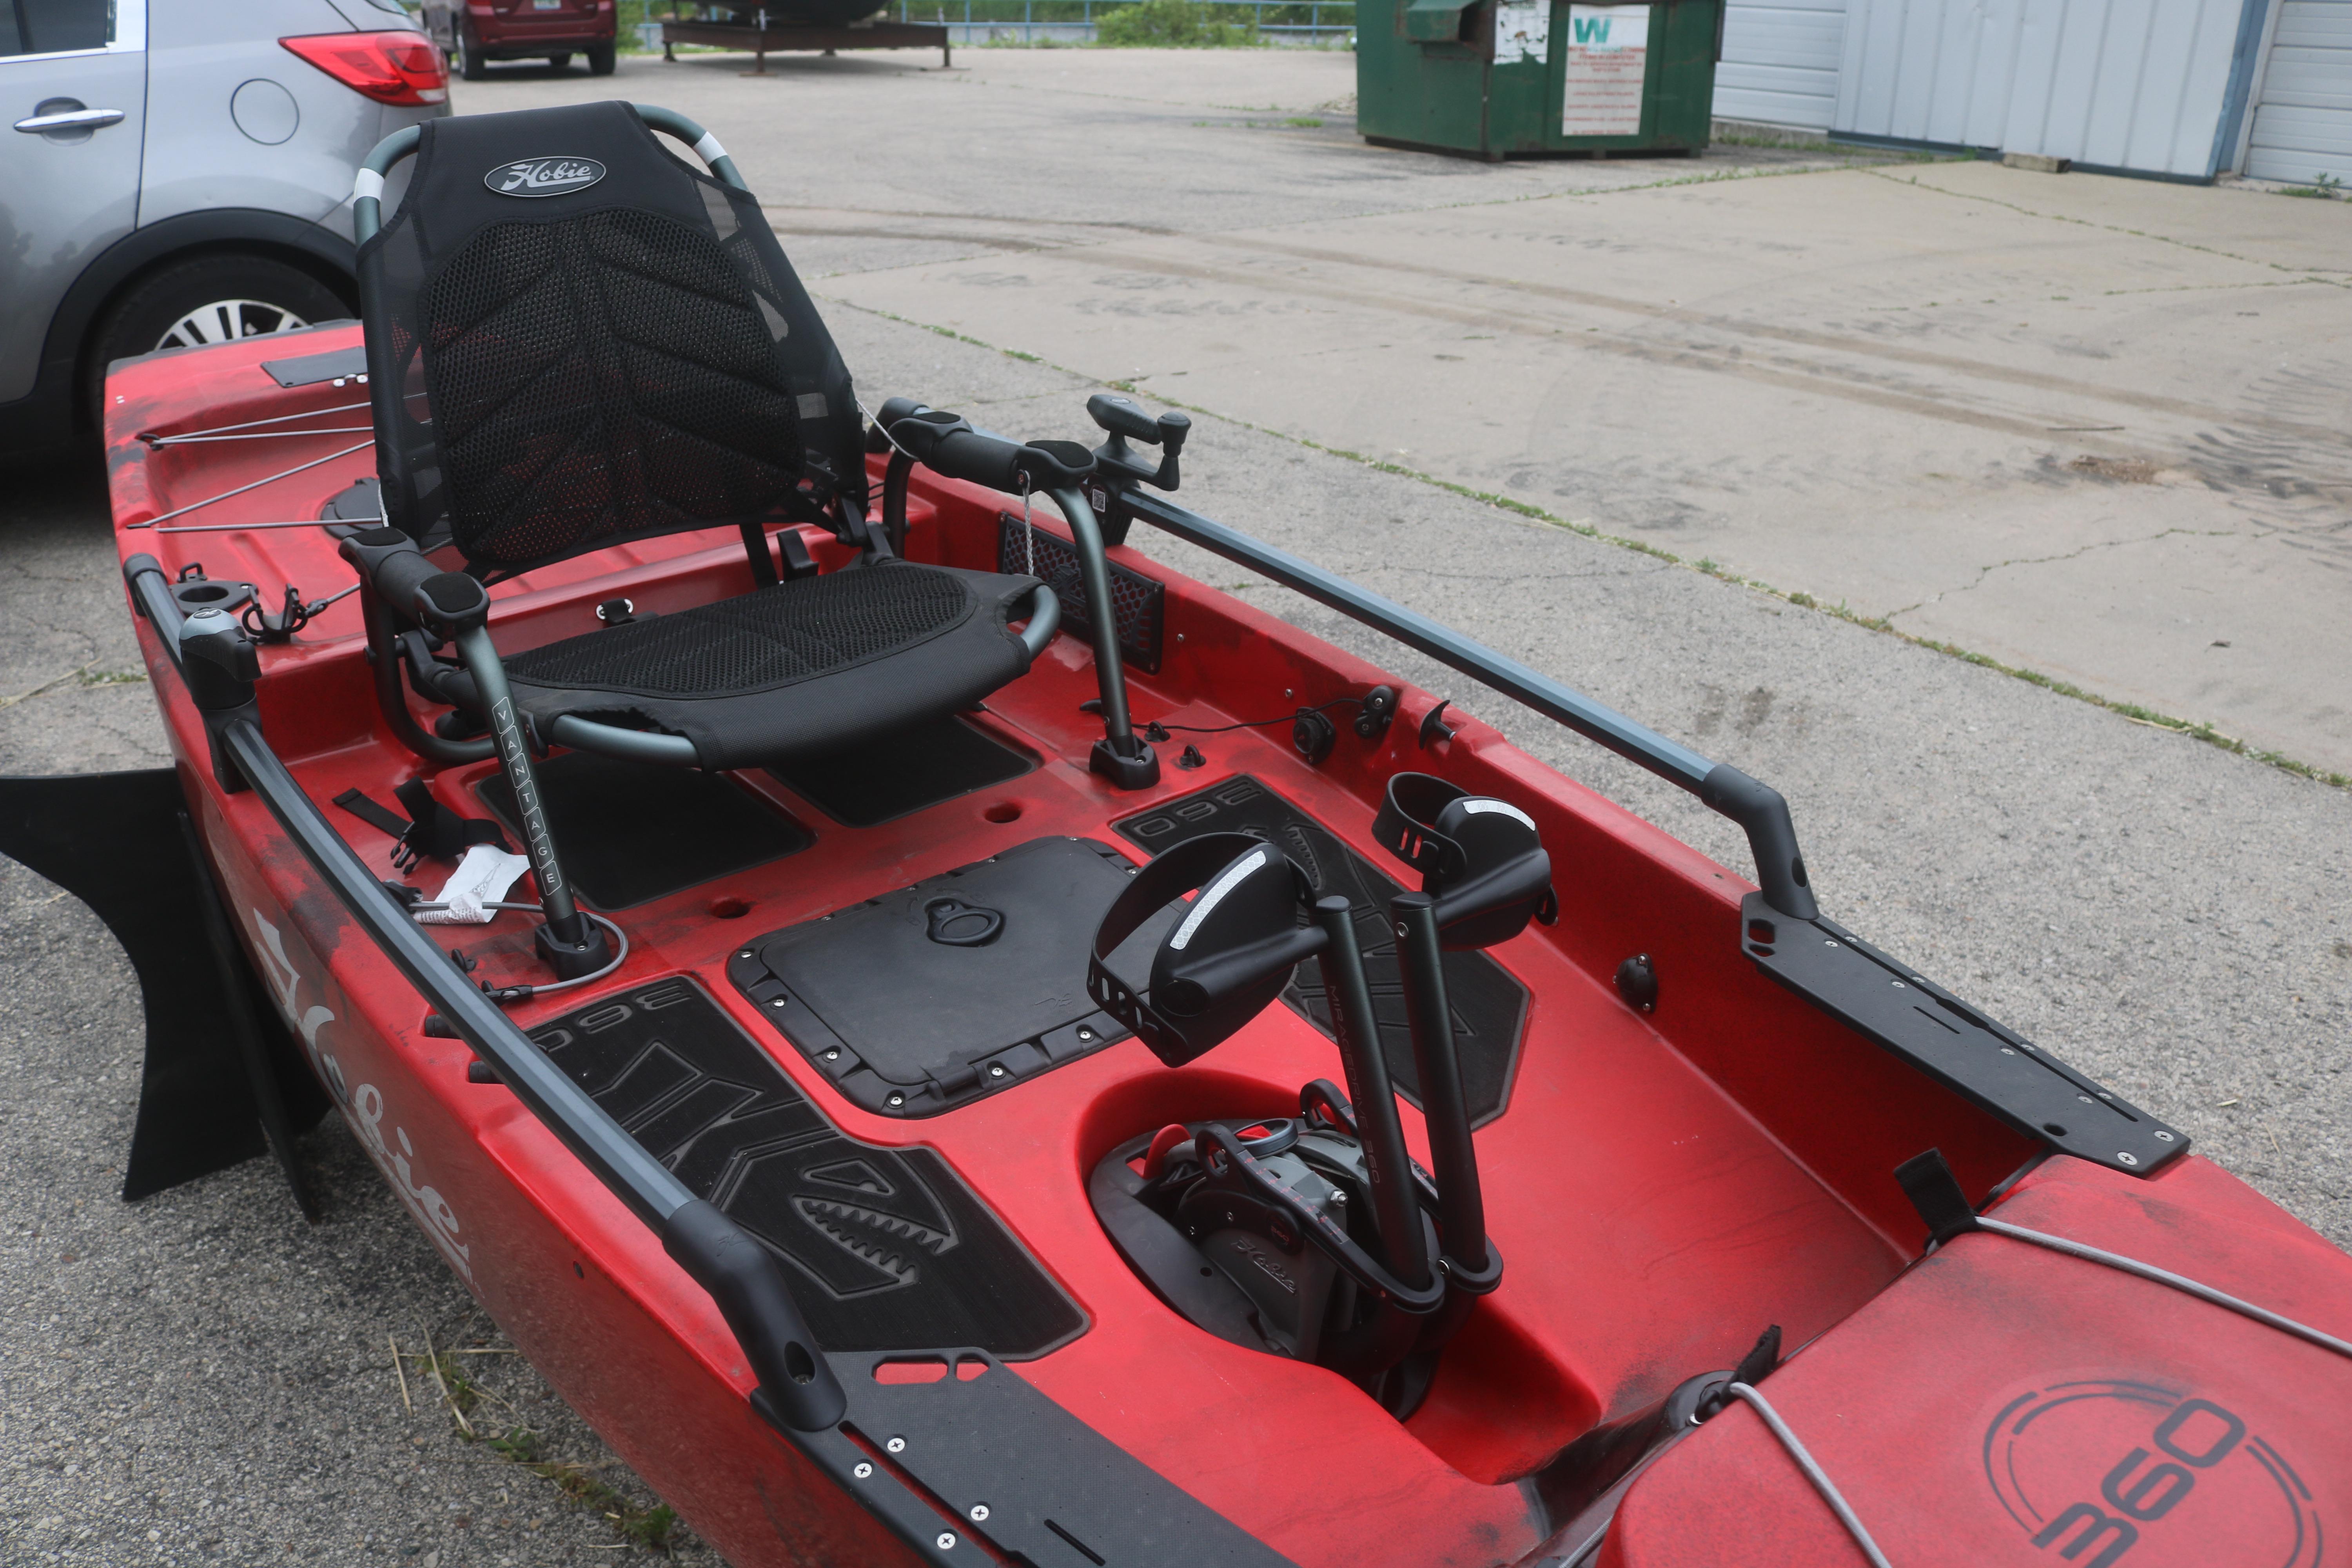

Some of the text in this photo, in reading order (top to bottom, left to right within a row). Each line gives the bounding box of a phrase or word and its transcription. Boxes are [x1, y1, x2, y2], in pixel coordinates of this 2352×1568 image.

[500, 161, 592, 191] Hobie
[497, 708, 556, 884] VANTAGE
[1133, 781, 1261, 837] 360
[253, 907, 473, 1284] Hobie
[1329, 985, 1380, 1183] MIRAGEDRIVE 360
[2031, 1398, 2246, 1568] 360
